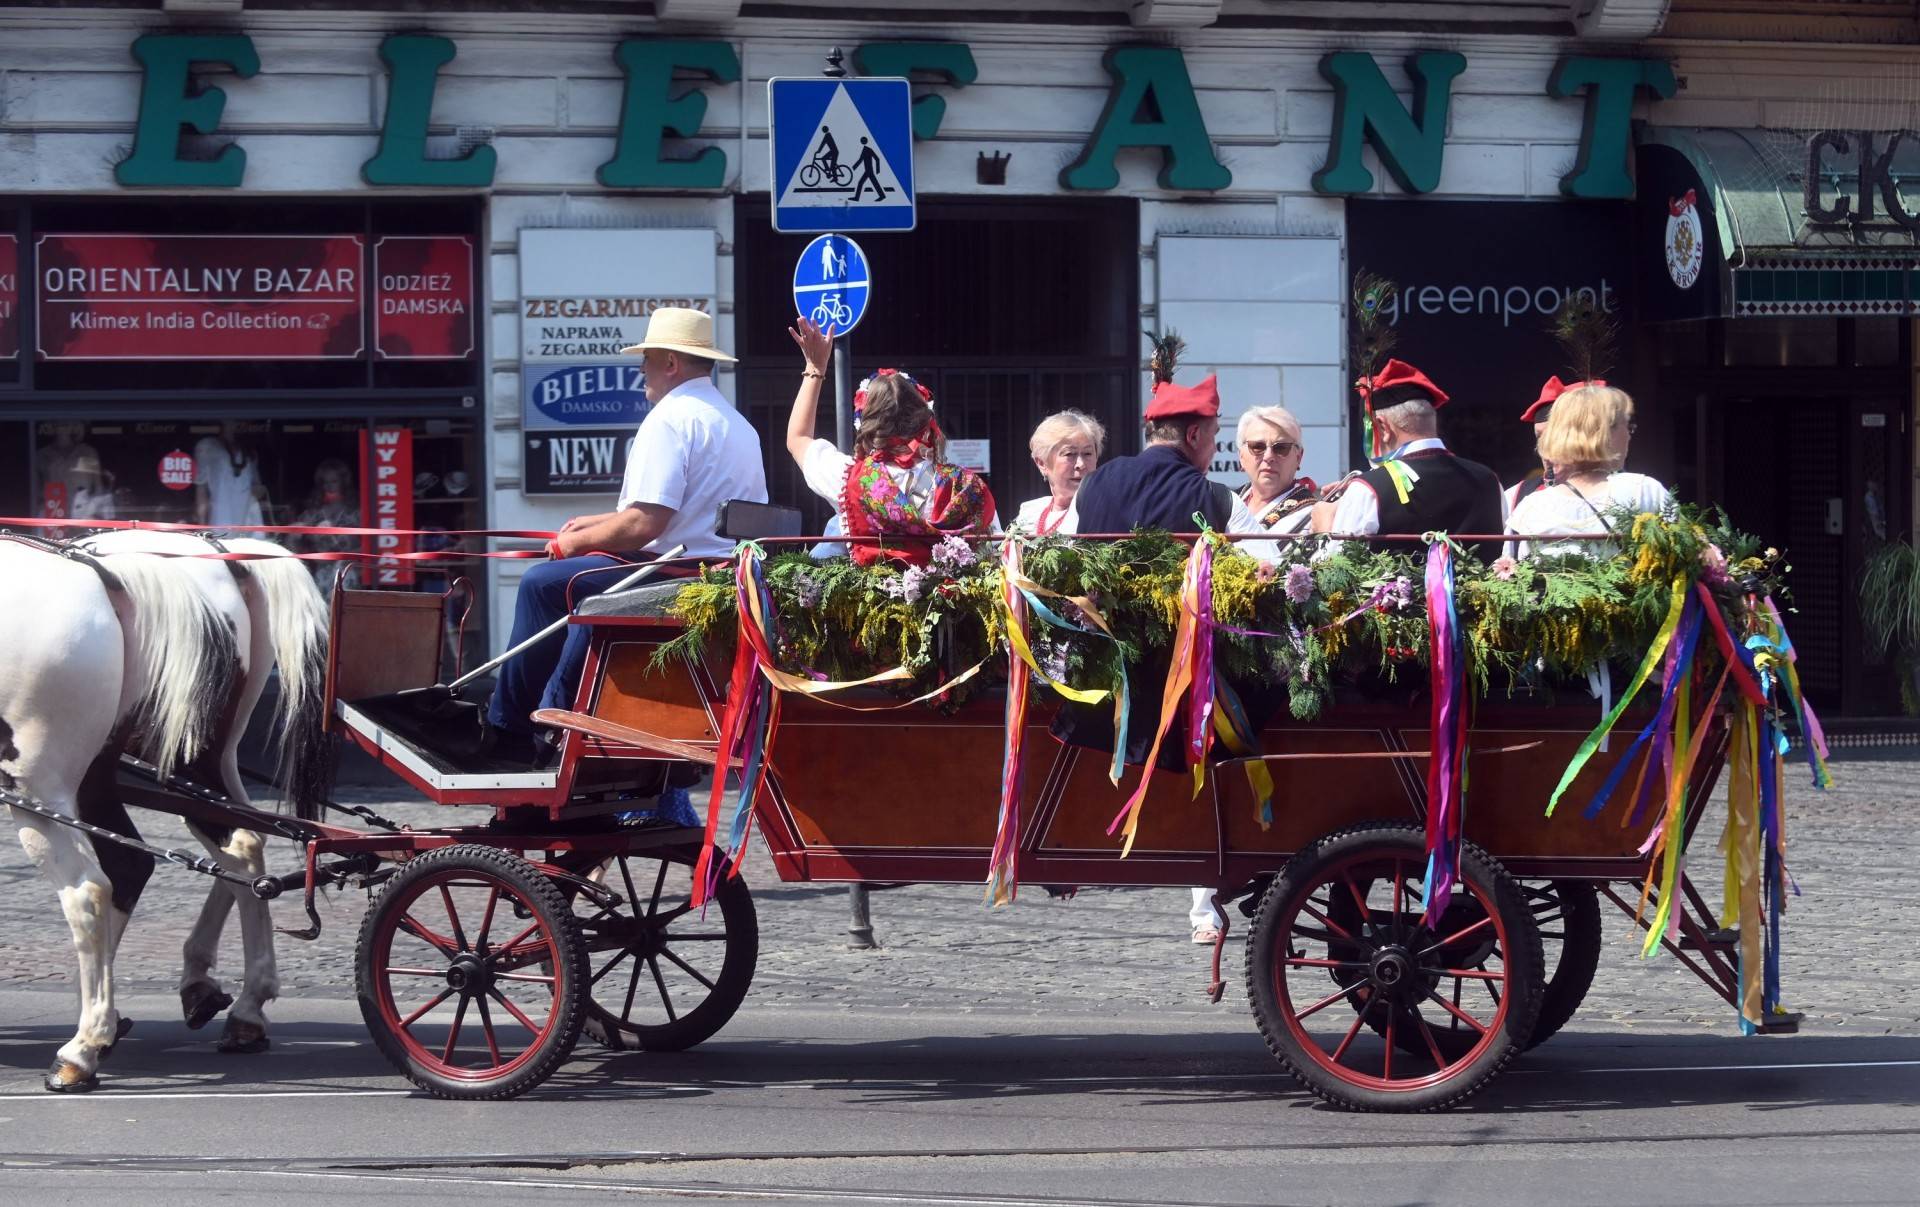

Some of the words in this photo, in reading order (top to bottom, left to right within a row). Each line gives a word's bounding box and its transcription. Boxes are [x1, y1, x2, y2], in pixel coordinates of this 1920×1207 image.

[45, 267, 242, 292] ORIENTALNY
[254, 267, 355, 292] BAZAR
[383, 298, 465, 315] DAMSKA
[70, 311, 140, 329] Klimex
[146, 311, 195, 329] India
[201, 311, 302, 329] Collection
[541, 326, 623, 340] NAPRAWA
[561, 401, 622, 413] DAMSKO
[549, 437, 617, 475] NEW
[163, 457, 192, 471] BIG
[161, 472, 192, 484] SALE
